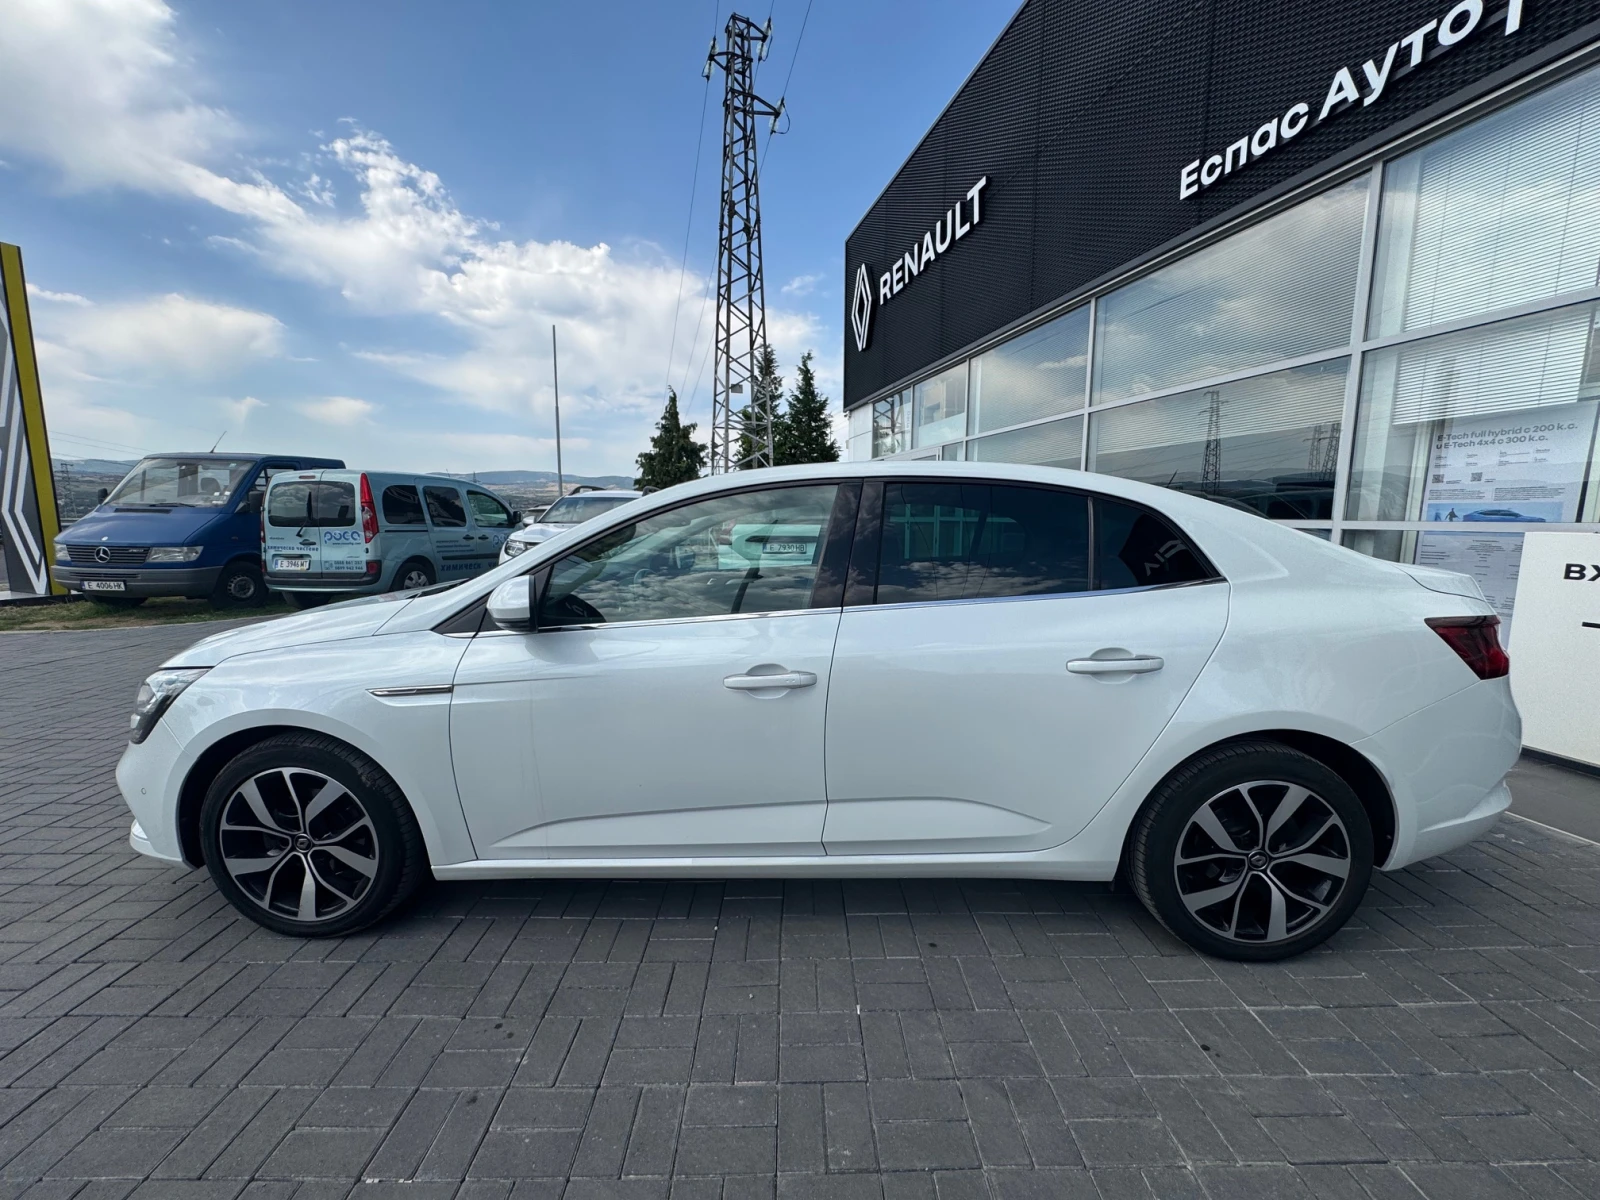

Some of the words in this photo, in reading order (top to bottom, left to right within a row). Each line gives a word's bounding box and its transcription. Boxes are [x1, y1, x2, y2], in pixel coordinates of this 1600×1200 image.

[1179, 102, 1309, 200] Еспас
[1318, 0, 1484, 121] Ауто
[879, 175, 987, 306] RENAULT
[1437, 433, 1469, 442] E-Tech
[1470, 431, 1486, 439] full
[1488, 426, 1522, 438] hybrid
[1532, 423, 1555, 433] 200
[1443, 438, 1475, 449] E-Tech
[1476, 438, 1496, 446] 4x4
[1505, 435, 1527, 444] 300
